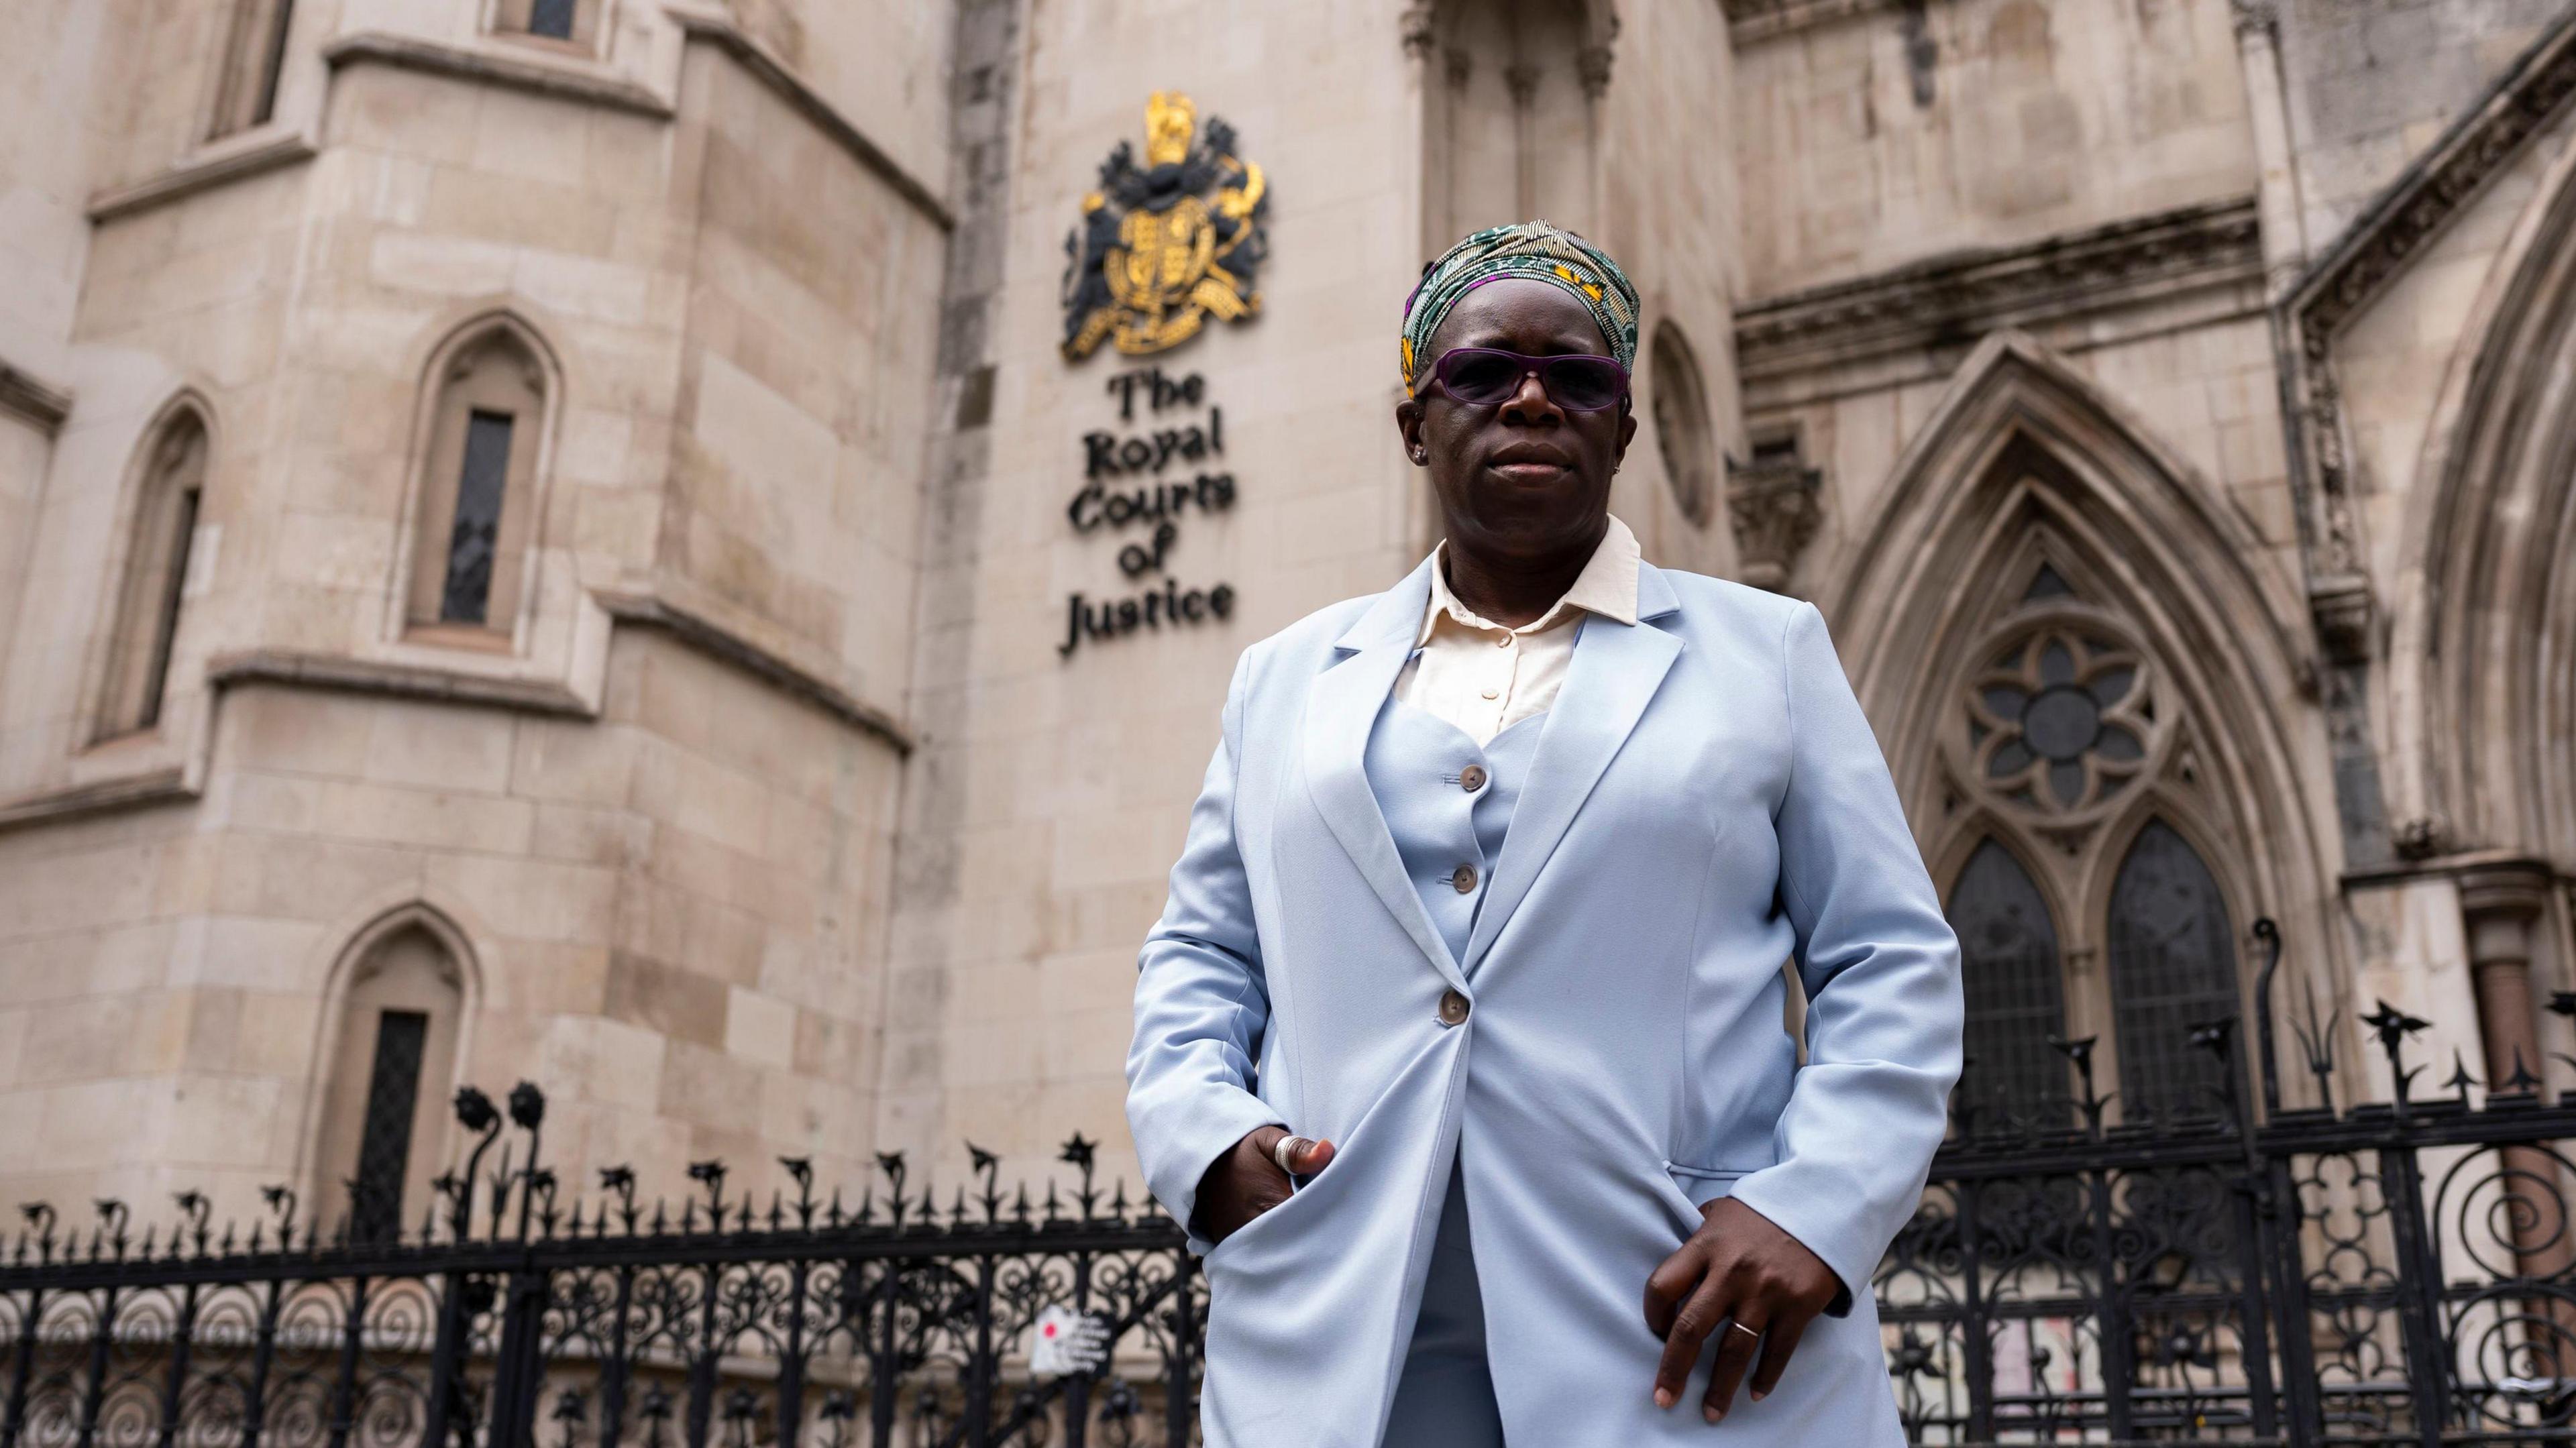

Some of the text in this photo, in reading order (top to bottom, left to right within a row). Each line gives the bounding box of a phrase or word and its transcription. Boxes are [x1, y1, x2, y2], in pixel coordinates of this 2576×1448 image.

[1108, 366, 1205, 421] The
[1083, 408, 1224, 480] Royal
[1067, 471, 1236, 532] Courts
[1118, 519, 1177, 578] of
[1059, 578, 1235, 658] Justice
